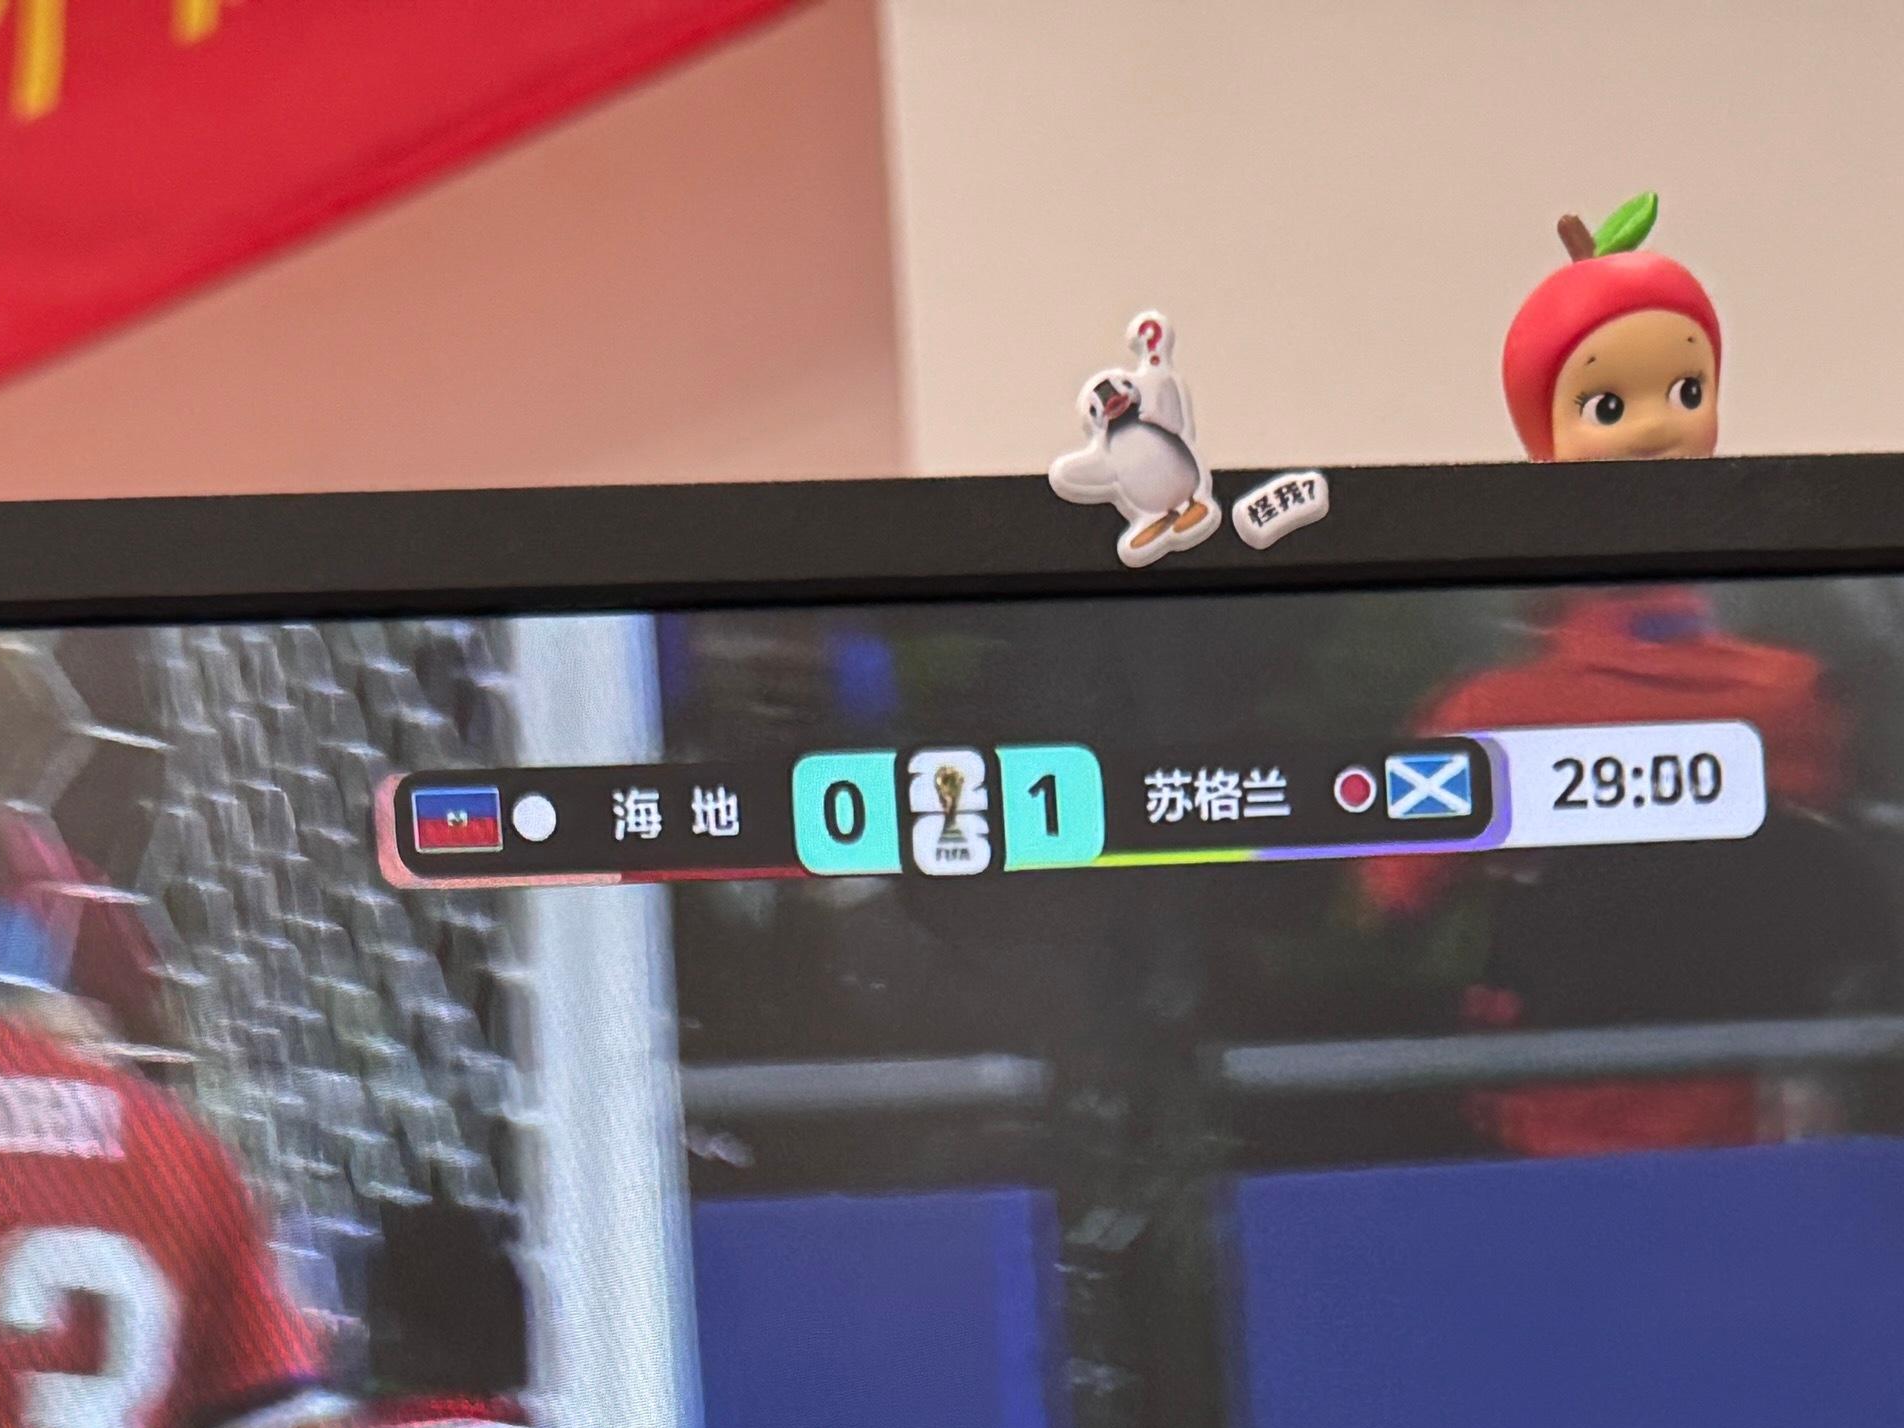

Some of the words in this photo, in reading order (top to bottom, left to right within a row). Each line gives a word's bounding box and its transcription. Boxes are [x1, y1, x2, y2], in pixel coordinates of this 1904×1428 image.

[823, 780, 866, 844] 0
[1028, 773, 1059, 837] 1
[1144, 767, 1291, 824] 苏格兰
